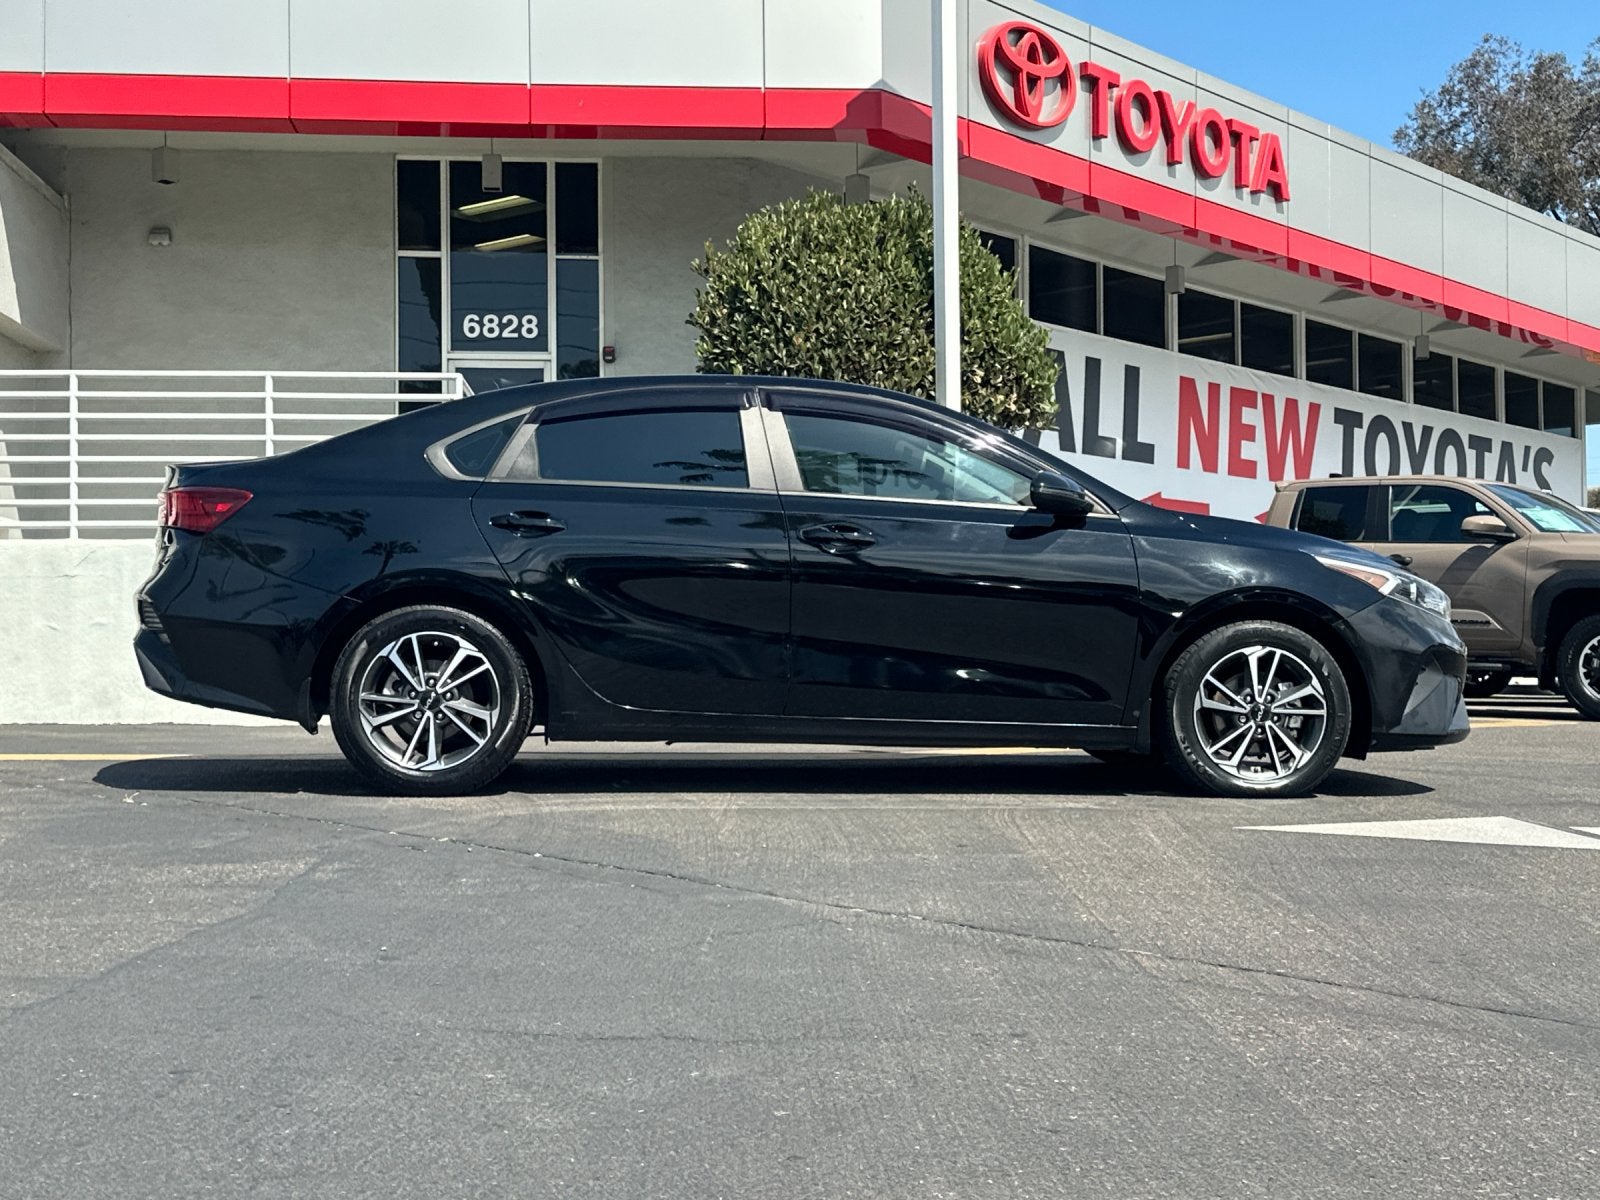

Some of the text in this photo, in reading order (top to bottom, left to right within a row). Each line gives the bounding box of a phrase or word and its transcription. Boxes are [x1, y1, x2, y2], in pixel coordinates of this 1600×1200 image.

[1079, 61, 1291, 202] TOYOTA
[462, 314, 539, 339] 6828
[1022, 347, 1555, 492] ALL NEW TOYOTA'S
